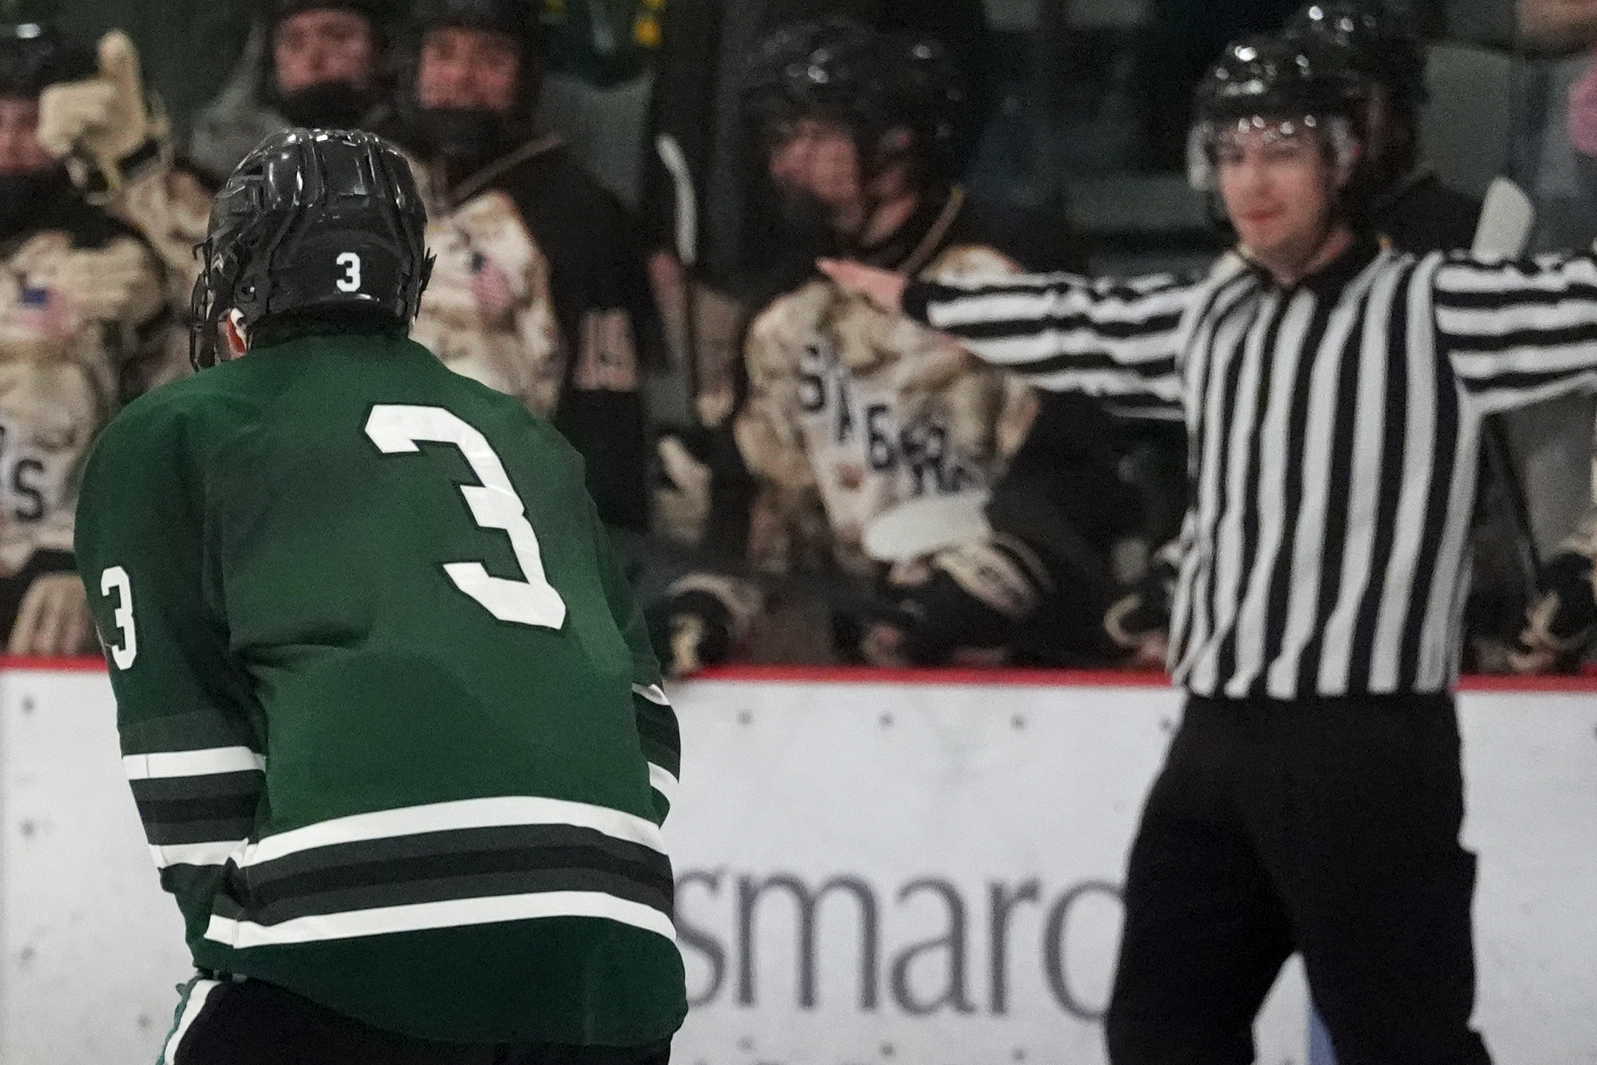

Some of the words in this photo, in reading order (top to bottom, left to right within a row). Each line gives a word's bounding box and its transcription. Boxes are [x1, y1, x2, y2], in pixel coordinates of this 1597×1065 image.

[334, 251, 362, 293] 3
[363, 403, 568, 631] 3
[99, 564, 139, 671] 3
[670, 864, 1126, 1022] smarc
